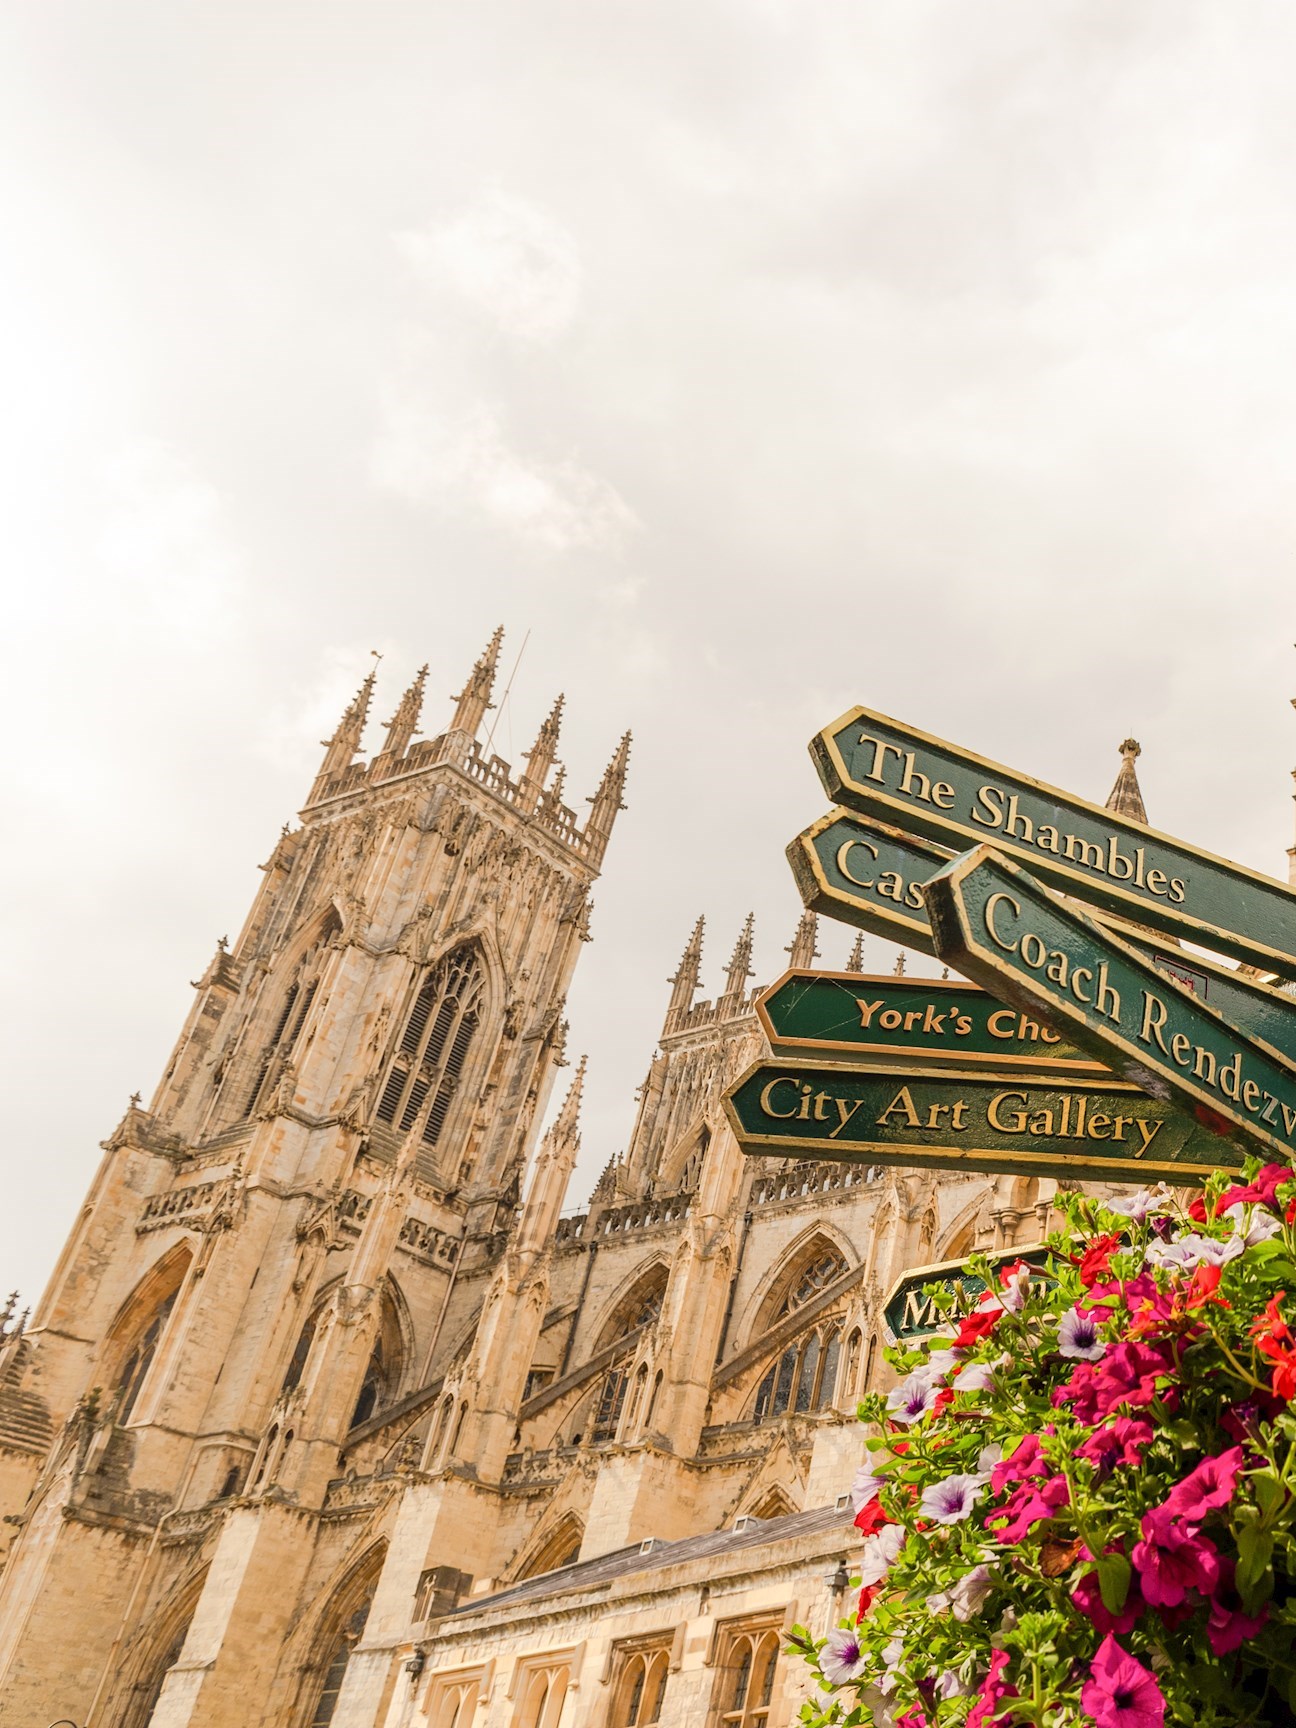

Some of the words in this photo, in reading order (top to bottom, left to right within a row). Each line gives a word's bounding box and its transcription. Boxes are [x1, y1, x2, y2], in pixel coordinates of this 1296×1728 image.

[860, 734, 957, 809] The
[970, 785, 1187, 903] Shambles
[836, 840, 925, 909] Cas
[984, 892, 1121, 1024] Coach
[856, 999, 973, 1036] York's
[987, 1009, 1062, 1044] Cho
[760, 1077, 864, 1138] City
[875, 1086, 969, 1131] Art
[986, 1091, 1164, 1159] Gallery
